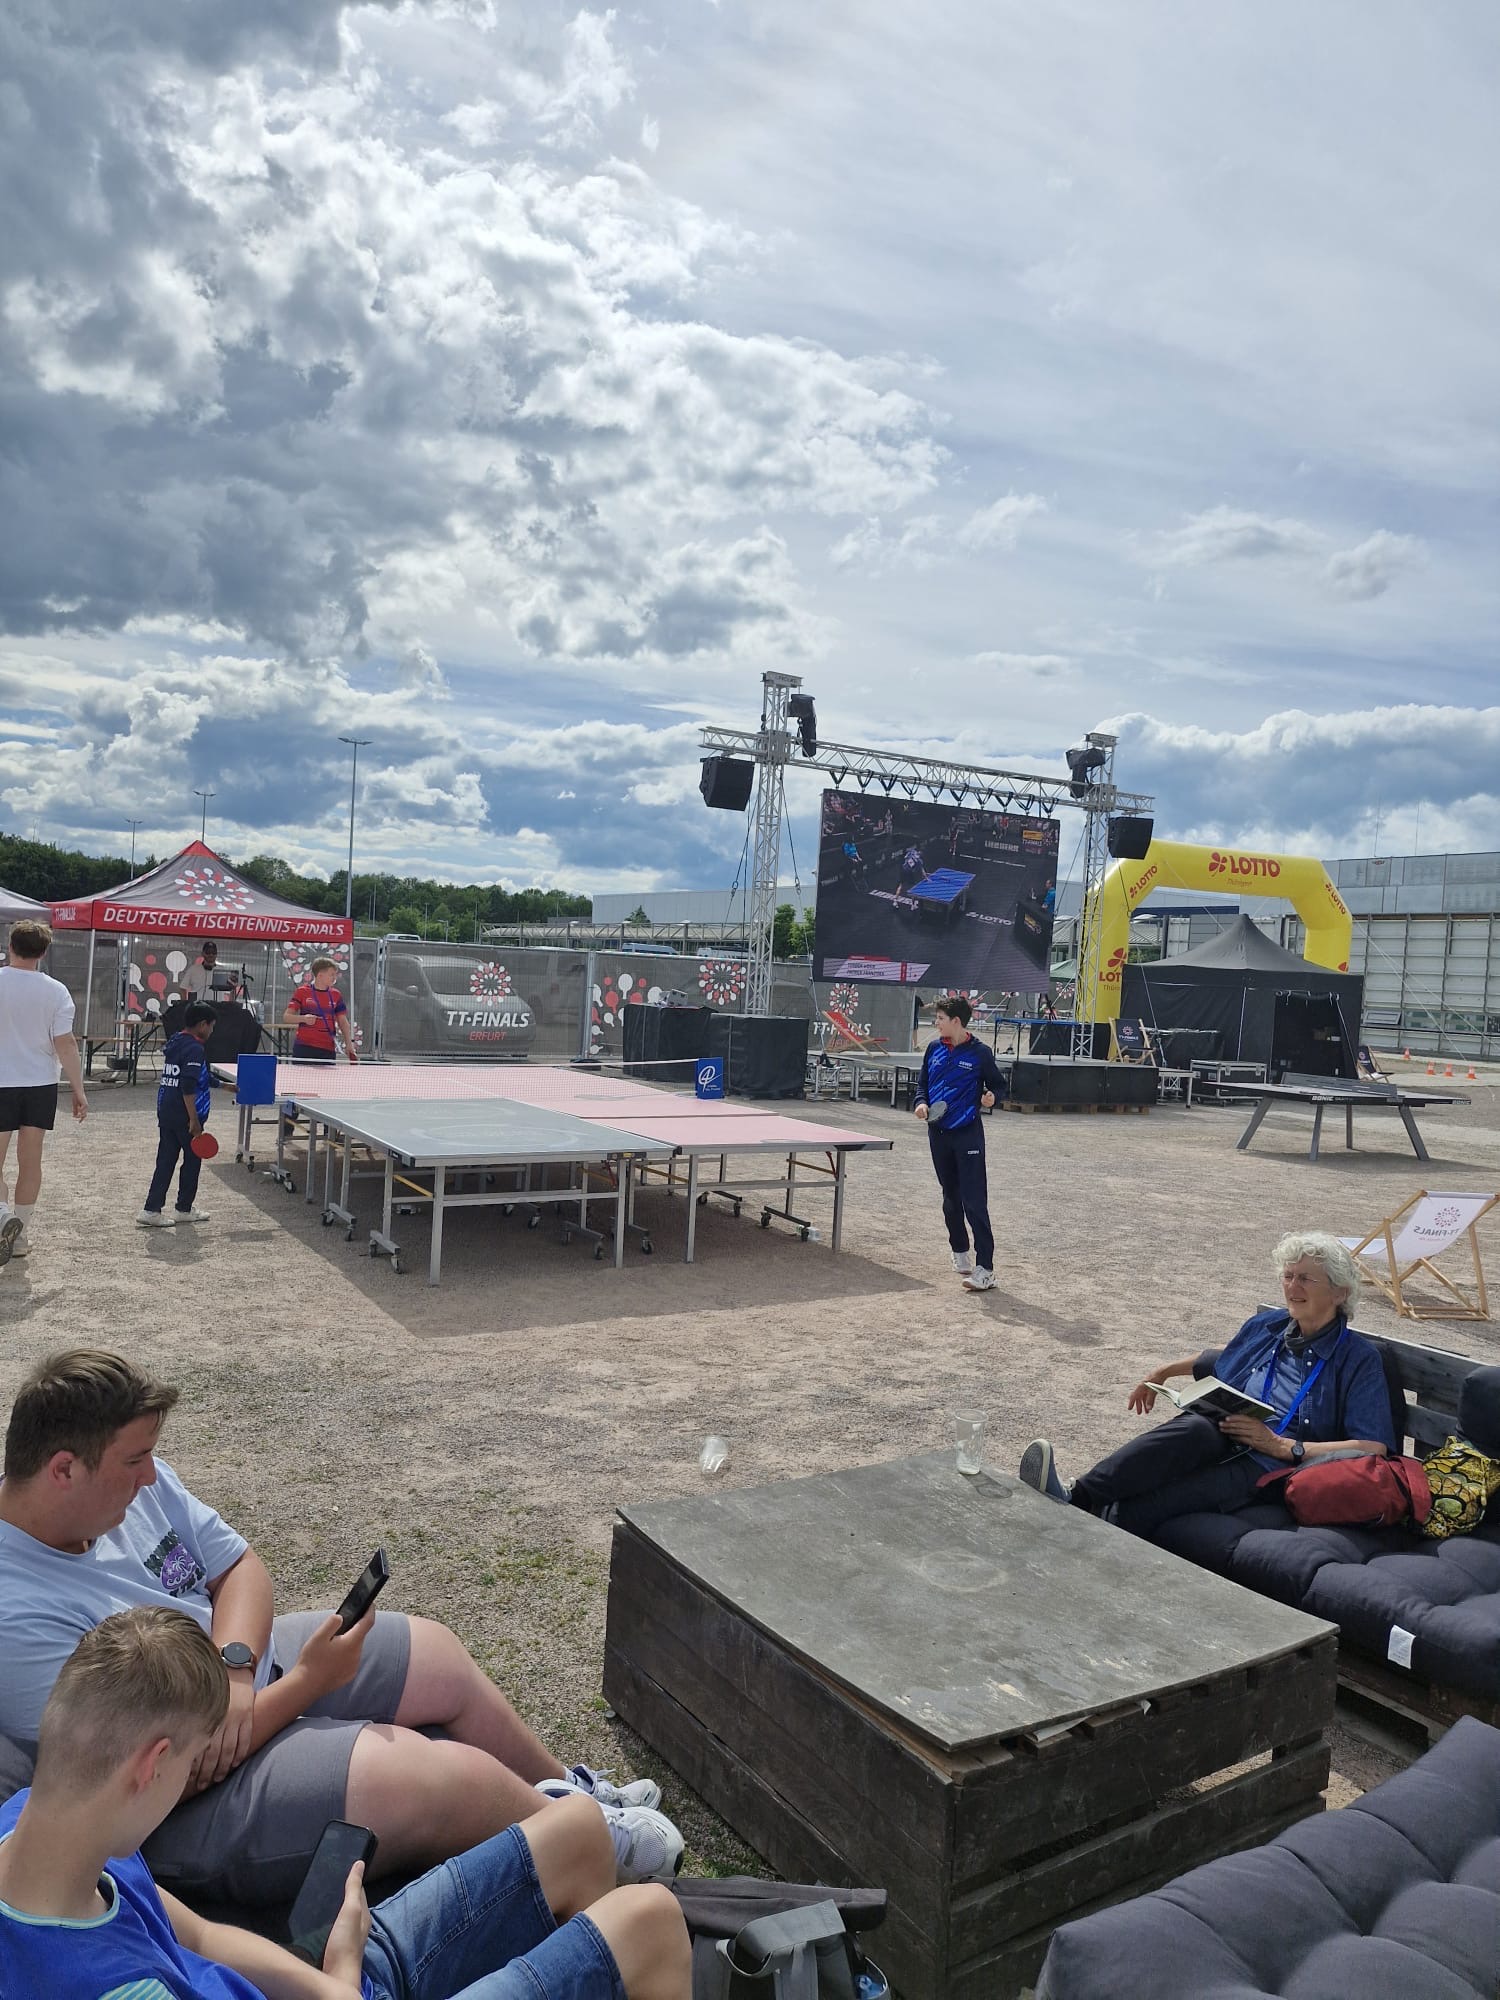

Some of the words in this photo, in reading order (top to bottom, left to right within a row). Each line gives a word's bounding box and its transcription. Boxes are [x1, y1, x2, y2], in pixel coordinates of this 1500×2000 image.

[1136, 865, 1158, 890] LOTTO
[1229, 855, 1281, 878] LOTTO
[1331, 890, 1346, 915] LOTTO
[103, 907, 190, 927] DEUTSCHE
[194, 914, 345, 936] TISCHTENNIS-FINALS
[979, 914, 1013, 926] LOTTO
[1099, 971, 1121, 982] LOT
[469, 1031, 507, 1041] ERFURT
